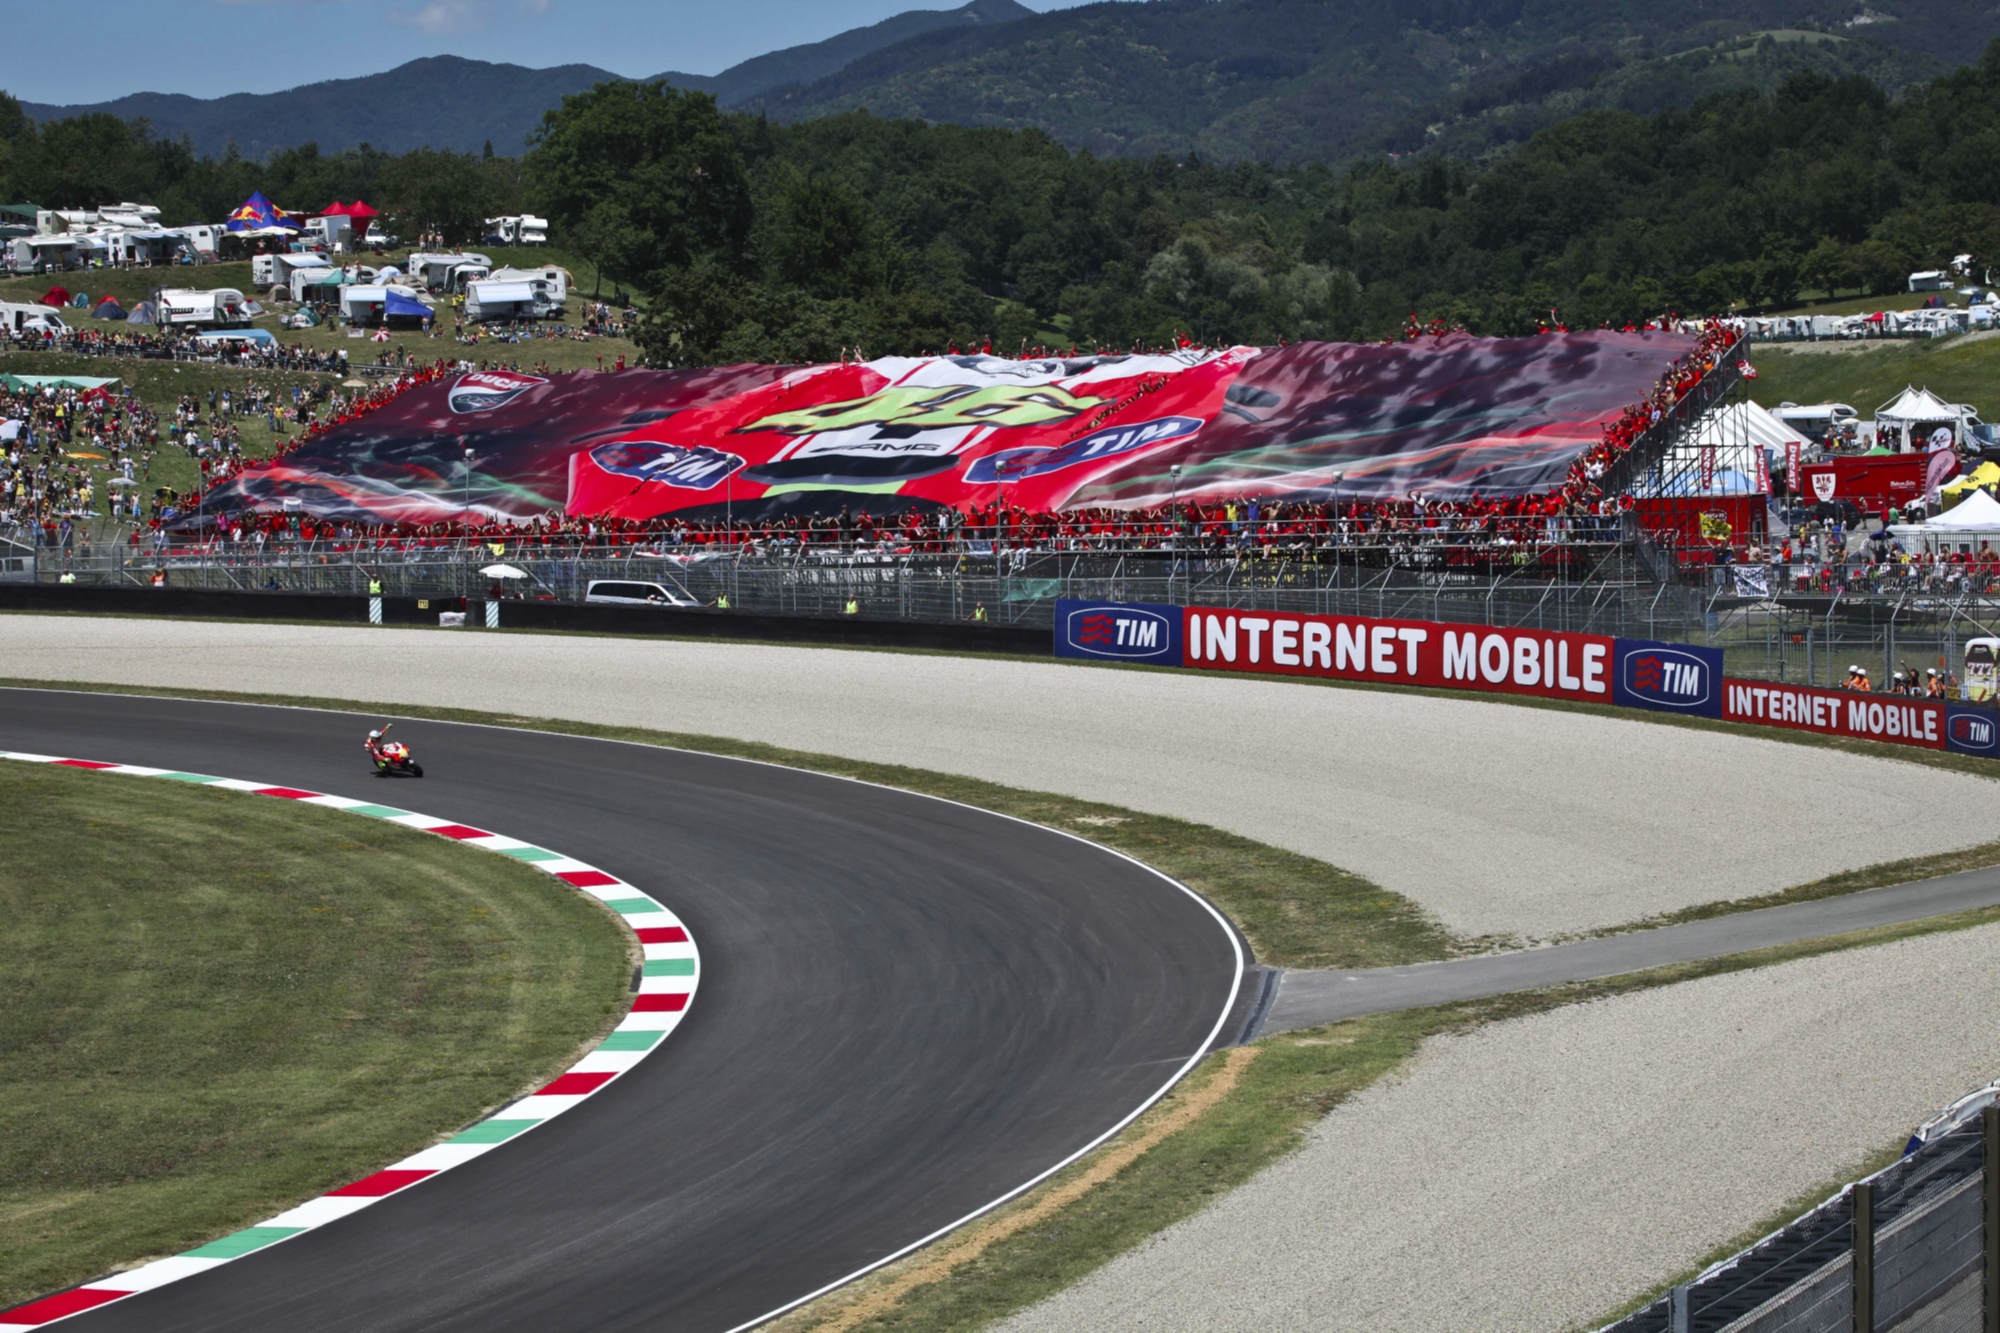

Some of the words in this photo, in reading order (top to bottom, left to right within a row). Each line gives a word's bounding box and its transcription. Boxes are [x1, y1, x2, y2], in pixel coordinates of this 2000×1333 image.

[735, 384, 1115, 434] 46
[857, 443, 941, 451] AMG
[1081, 422, 1181, 457] TIM
[638, 452, 727, 482] TIM
[1788, 445, 1797, 489] DUCATI
[1115, 618, 1157, 647] TIM
[1190, 614, 1427, 676] INTERNET
[1443, 630, 1607, 693] MOBILE
[1967, 662, 1994, 676] 777
[1662, 661, 1699, 696] TIM
[1728, 685, 1841, 728] INTERNET
[1848, 700, 1938, 741] MOBILE
[1970, 722, 1989, 742] TIM
